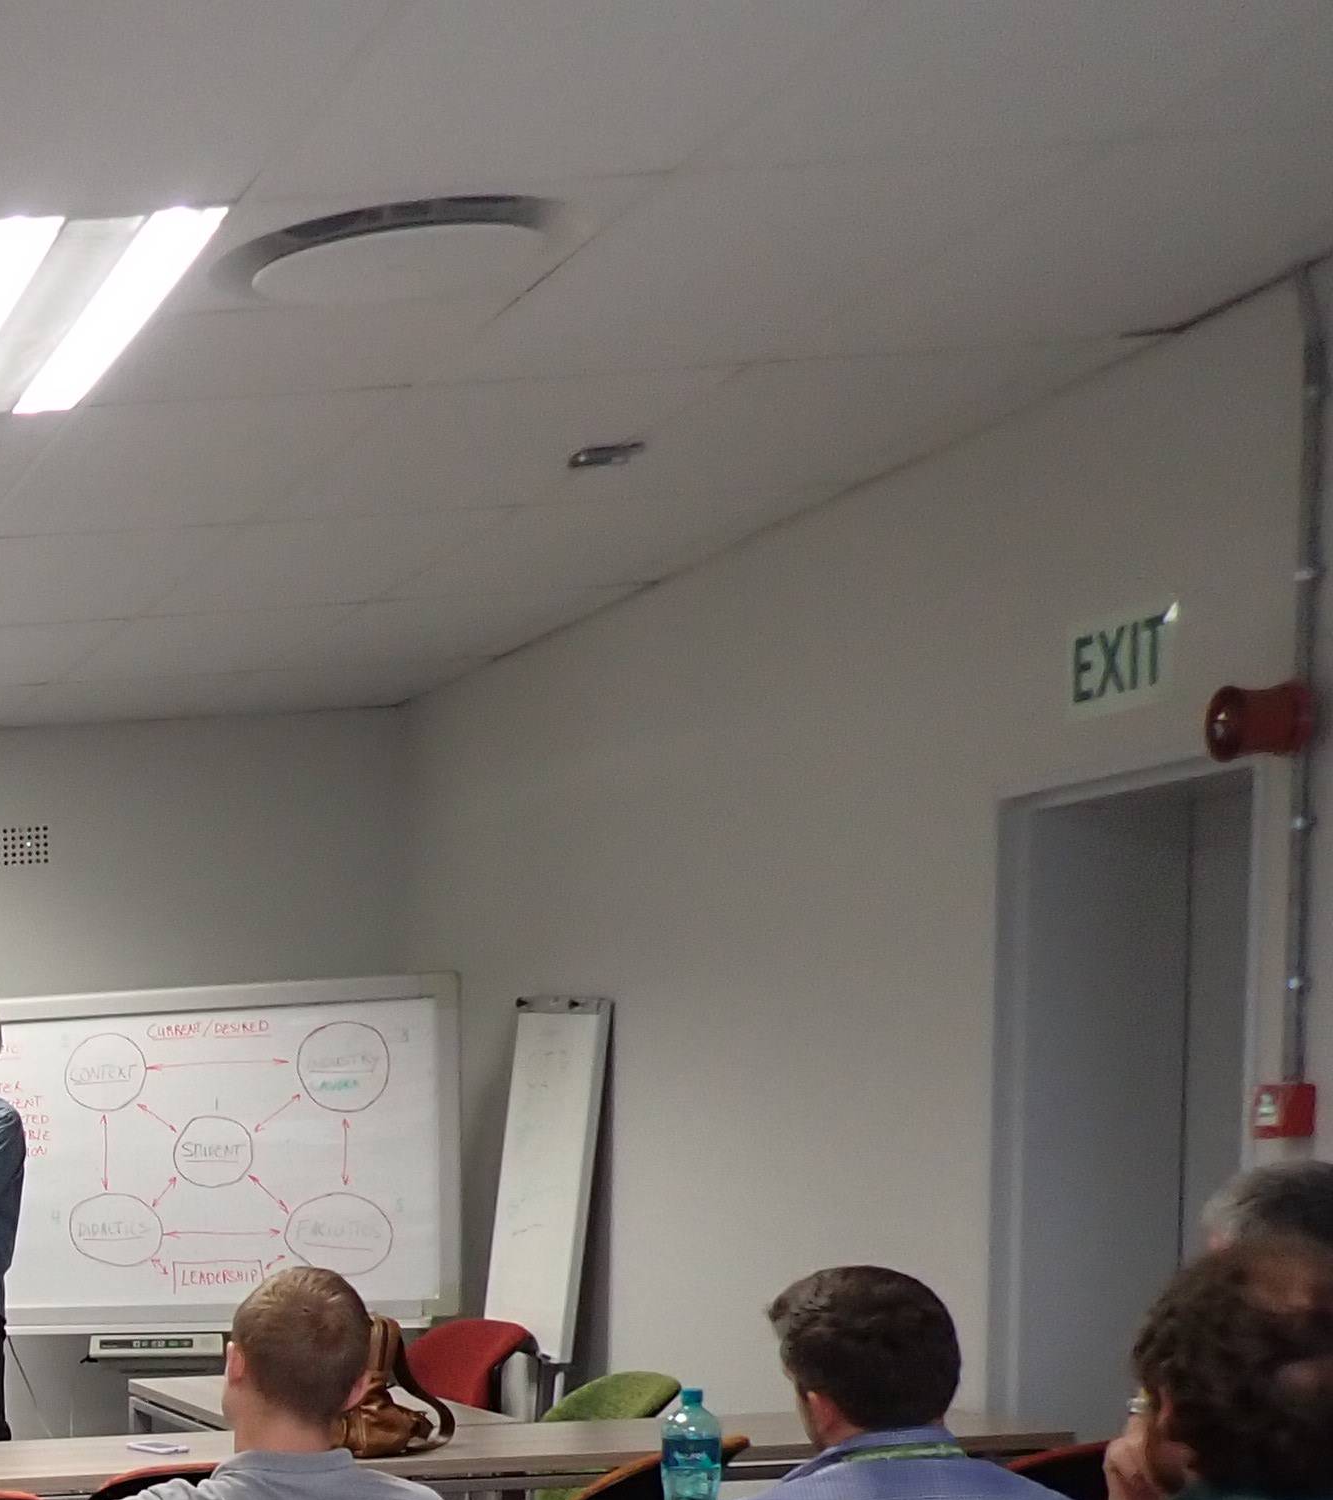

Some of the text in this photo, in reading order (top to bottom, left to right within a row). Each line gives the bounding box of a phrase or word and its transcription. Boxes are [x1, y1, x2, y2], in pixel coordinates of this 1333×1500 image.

[1072, 611, 1167, 703] EXIT
[70, 1064, 137, 1083] CONTEXT
[10, 1095, 43, 1108] ENT
[23, 1114, 49, 1124] TED
[181, 1269, 259, 1286] LEADERSHIP
